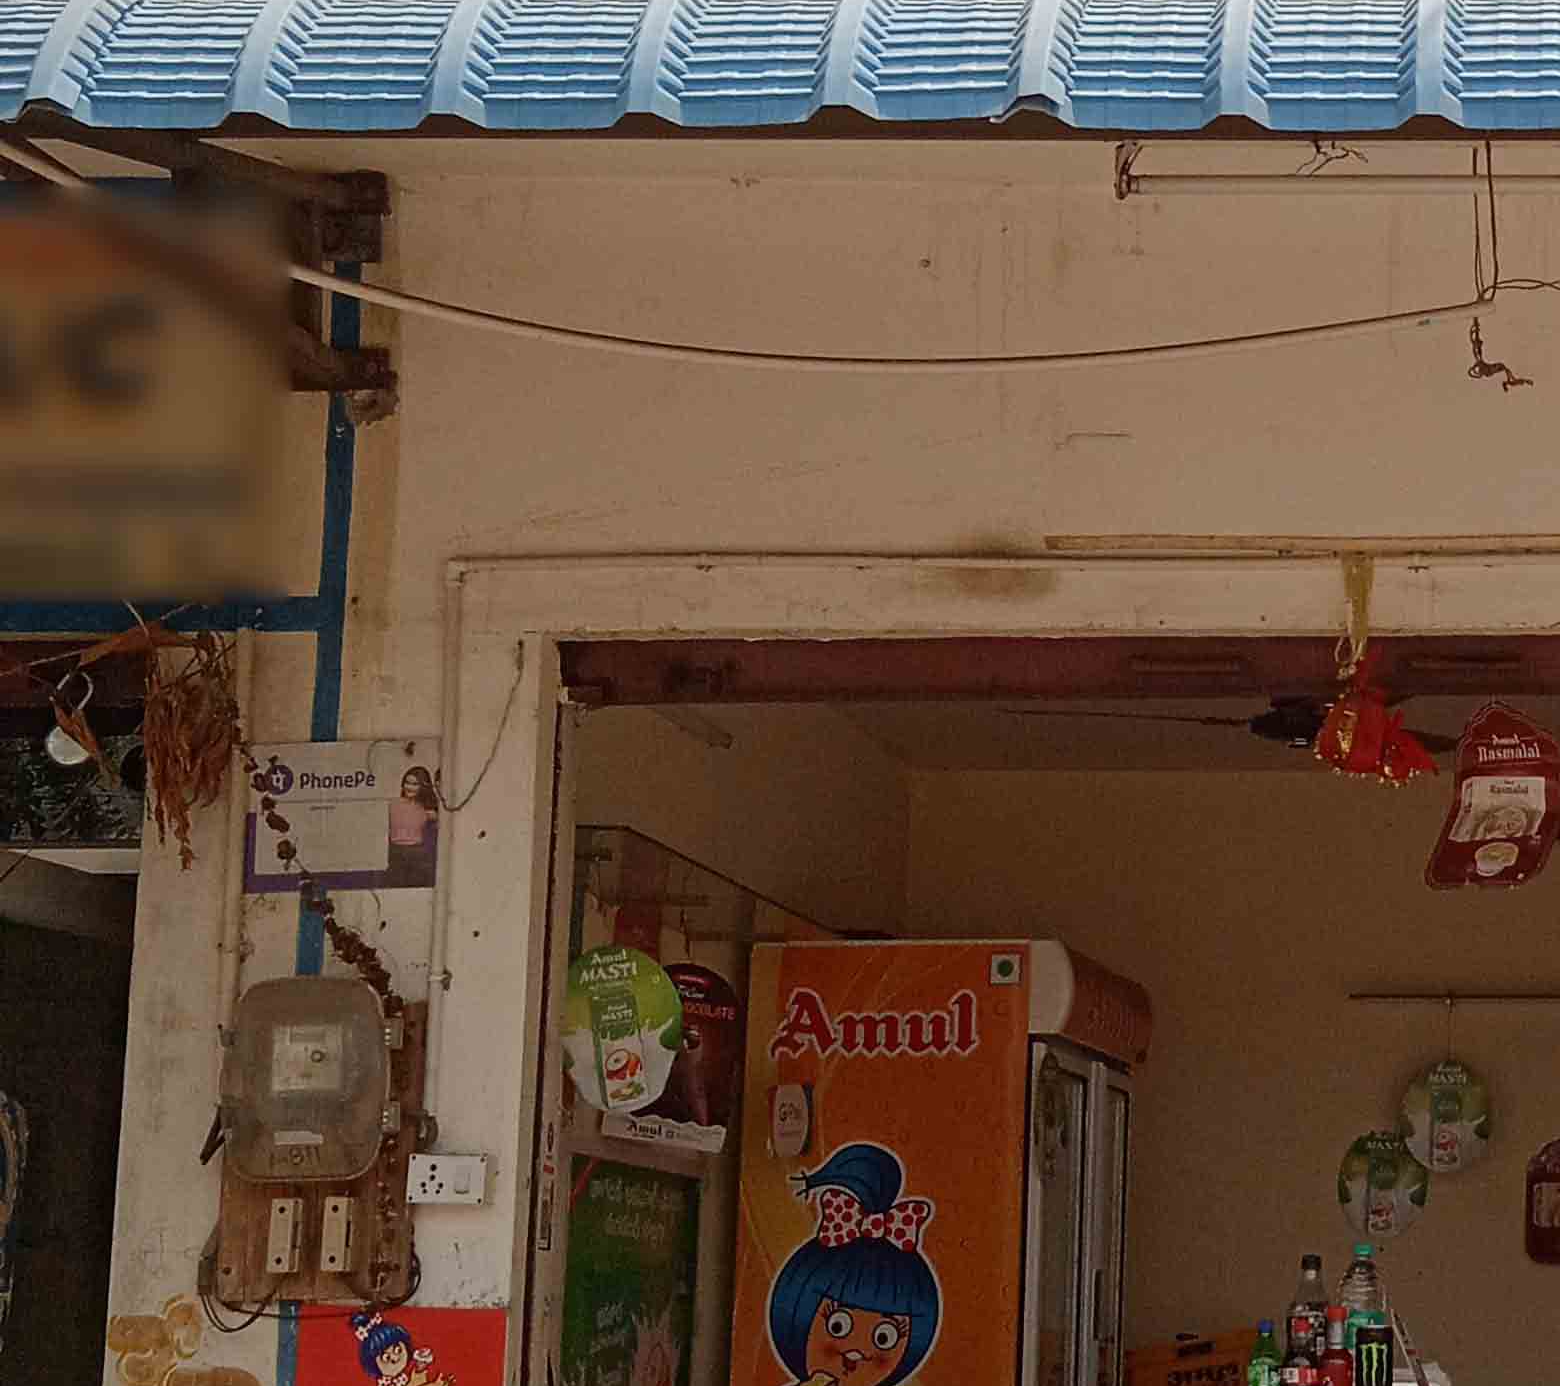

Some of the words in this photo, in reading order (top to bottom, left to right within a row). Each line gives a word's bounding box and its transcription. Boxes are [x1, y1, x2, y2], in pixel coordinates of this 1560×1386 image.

[299, 770, 376, 789] PhonePe
[579, 962, 639, 984] MASTI
[770, 988, 981, 1059] Amul
